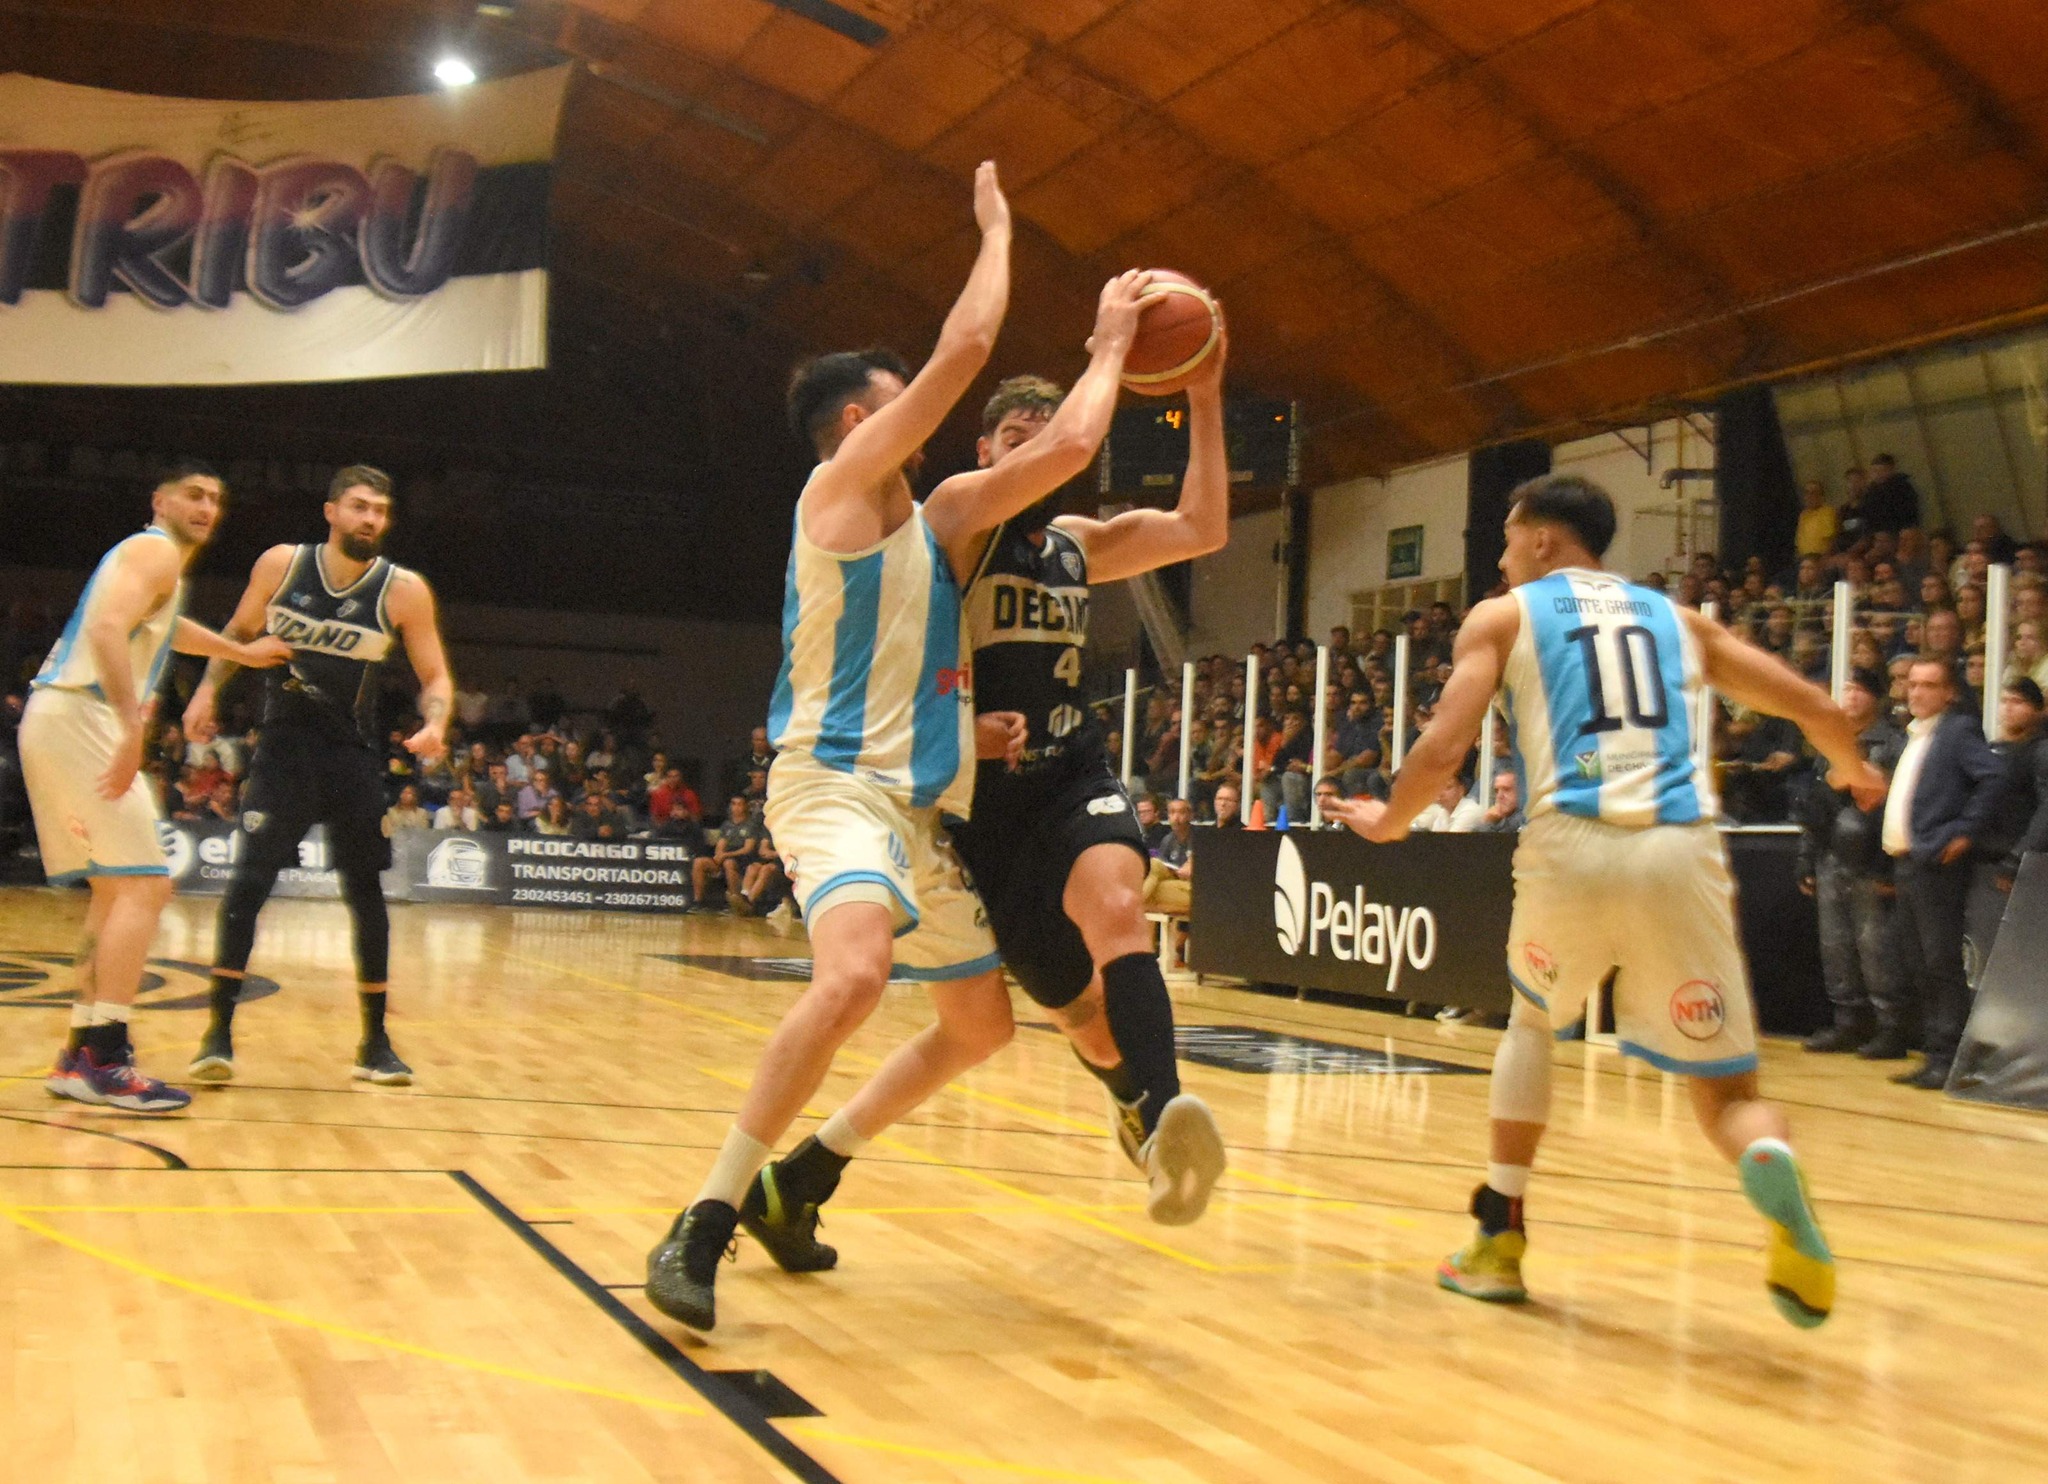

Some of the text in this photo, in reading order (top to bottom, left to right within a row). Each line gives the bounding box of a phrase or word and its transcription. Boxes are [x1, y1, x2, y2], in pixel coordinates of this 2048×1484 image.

[1553, 597, 1653, 618] CONTE GRAND
[1053, 646, 1081, 688] 4
[1564, 624, 1668, 736] 10
[507, 838, 689, 862] PICOCARGO SRL
[511, 863, 683, 885] TRANSPORTADORA
[512, 888, 592, 904] 2302453451
[604, 892, 684, 906] 2302671906
[1309, 881, 1437, 992] Pelayo
